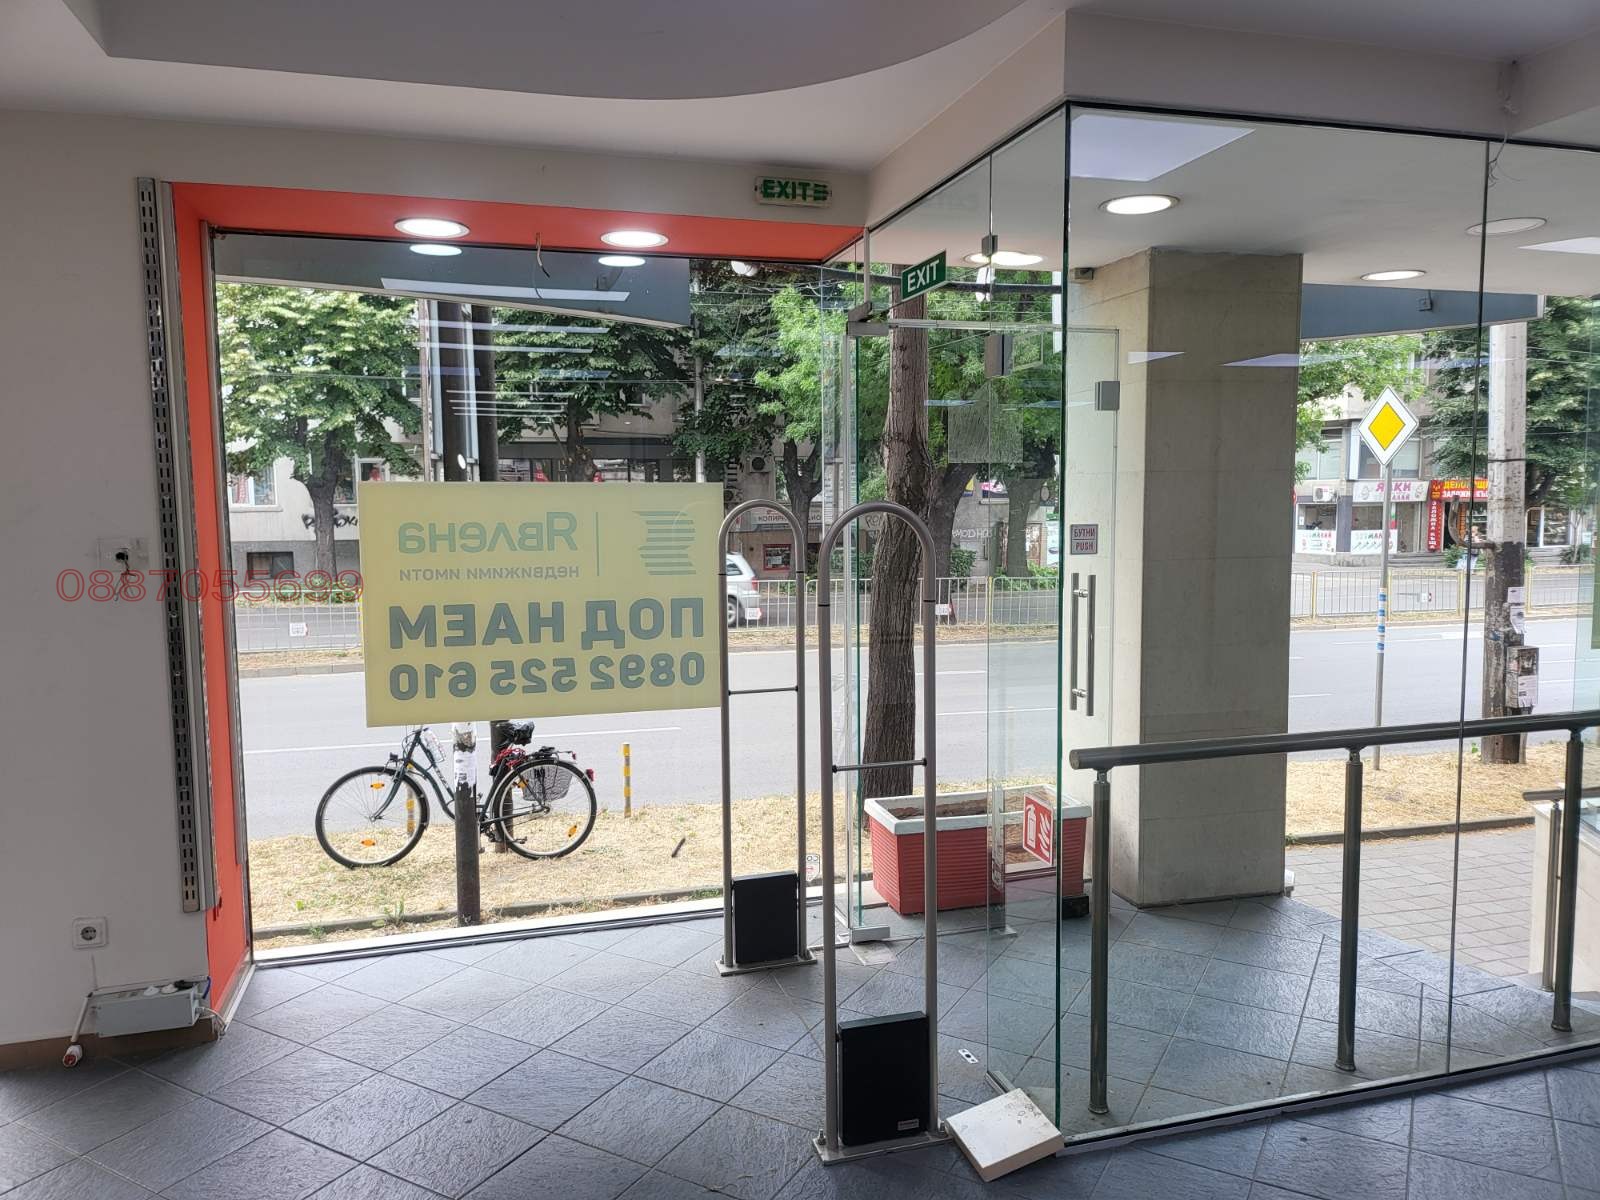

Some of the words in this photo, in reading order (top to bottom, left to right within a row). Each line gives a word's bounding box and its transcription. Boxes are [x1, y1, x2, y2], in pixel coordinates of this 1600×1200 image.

[762, 179, 811, 202] EXIT
[907, 260, 940, 293] EXIT
[1074, 528, 1096, 538] БУТНИ
[1075, 541, 1094, 551] PUSH
